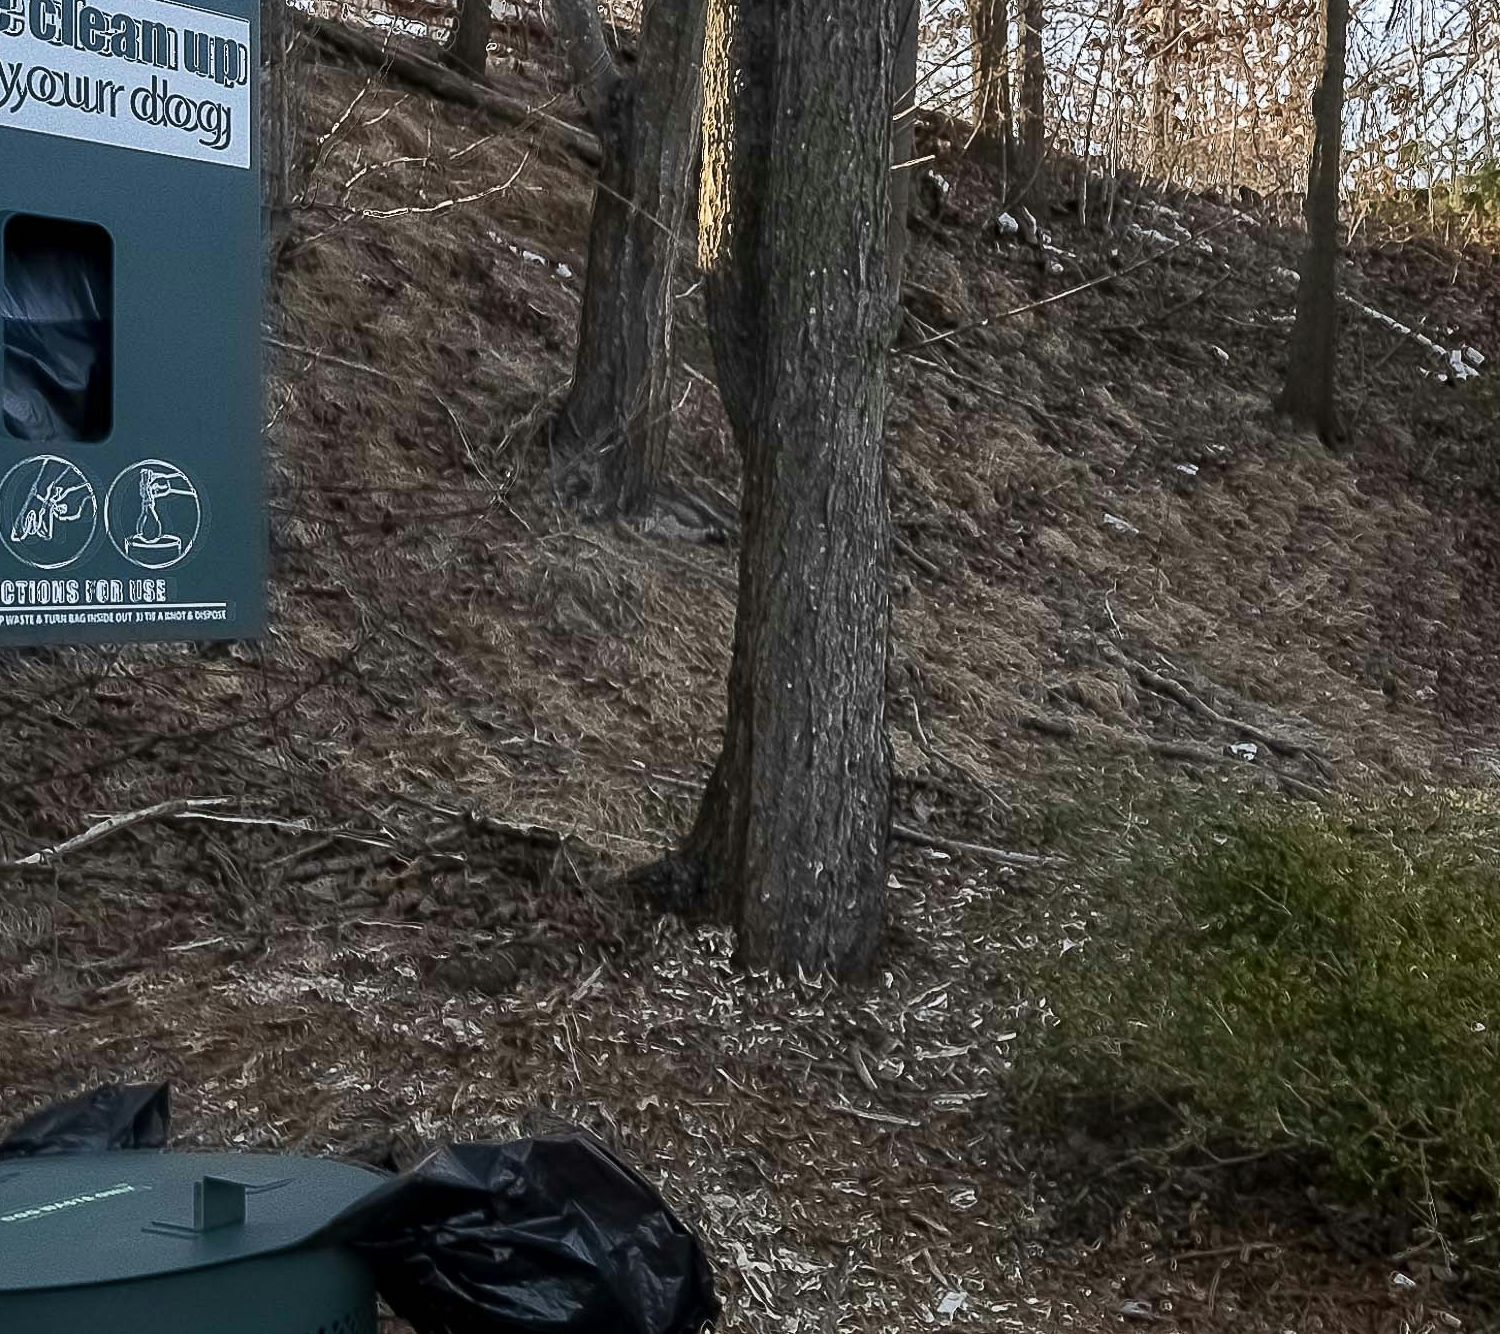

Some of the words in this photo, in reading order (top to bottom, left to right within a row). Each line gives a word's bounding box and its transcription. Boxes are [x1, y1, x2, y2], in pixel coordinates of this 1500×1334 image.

[183, 28, 248, 89] up
[130, 74, 232, 151] dog
[85, 578, 124, 604] FOR
[129, 578, 167, 603] USE
[5, 614, 35, 626] WASTE
[115, 611, 133, 623] OUT
